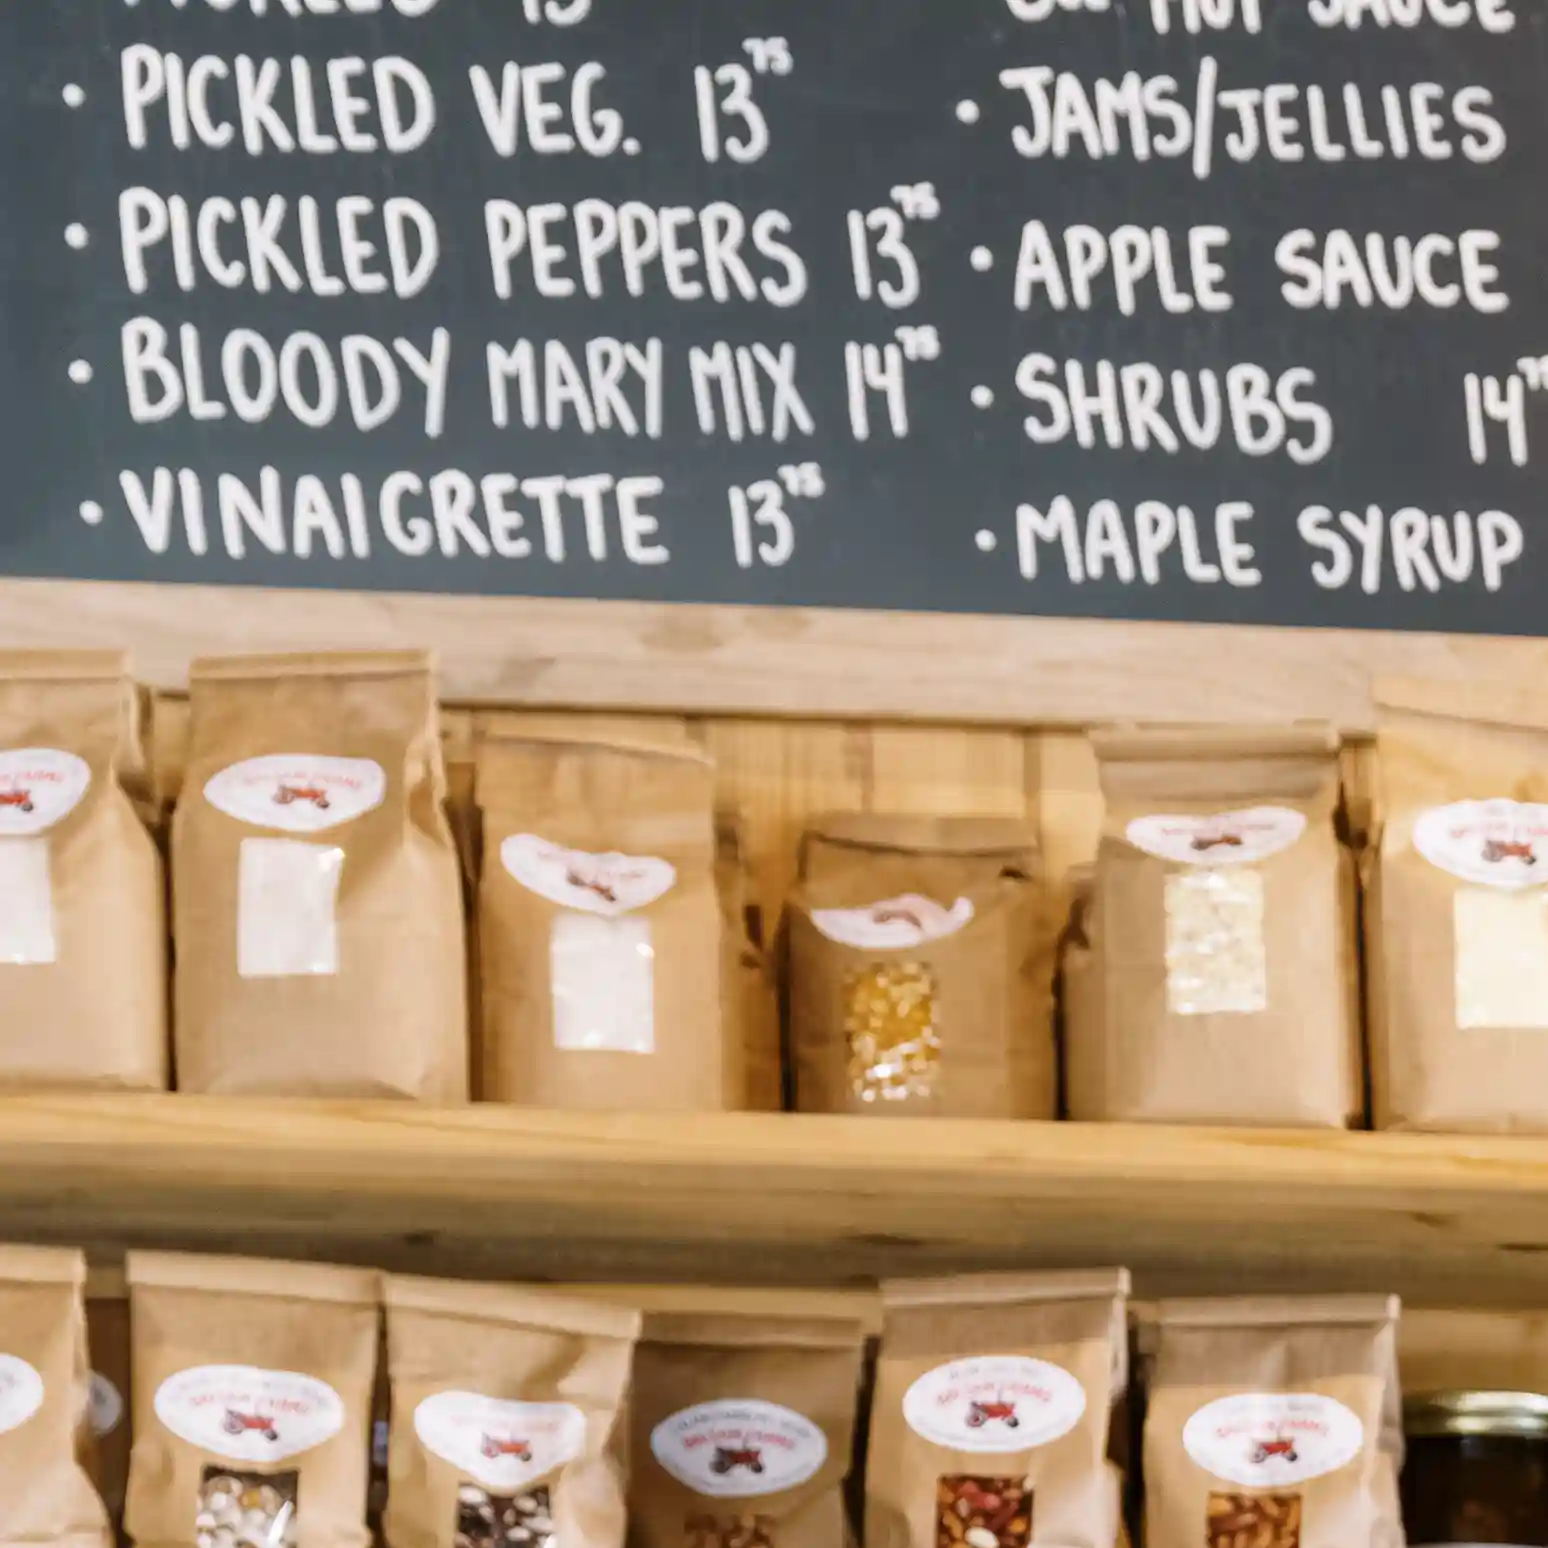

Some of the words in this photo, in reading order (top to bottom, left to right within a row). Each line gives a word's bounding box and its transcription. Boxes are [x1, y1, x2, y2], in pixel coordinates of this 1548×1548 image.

[121, 43, 436, 156] PICKLED
[468, 60, 642, 157] VEG.
[1000, 56, 1508, 180] JAMS/JELLIES
[118, 186, 440, 298] PICKLED
[483, 198, 808, 307] PEPPERS
[1013, 219, 1234, 315] APPLE
[1273, 229, 1510, 315] SAUCE
[119, 315, 452, 438] BLOODY
[486, 337, 663, 438] MARY
[688, 341, 815, 442] MIX
[1014, 352, 1334, 465] SHRUBS
[119, 465, 672, 564] VINAIGRETTE
[1014, 493, 1262, 585] MAPLE
[1297, 504, 1526, 594] SYRUP
